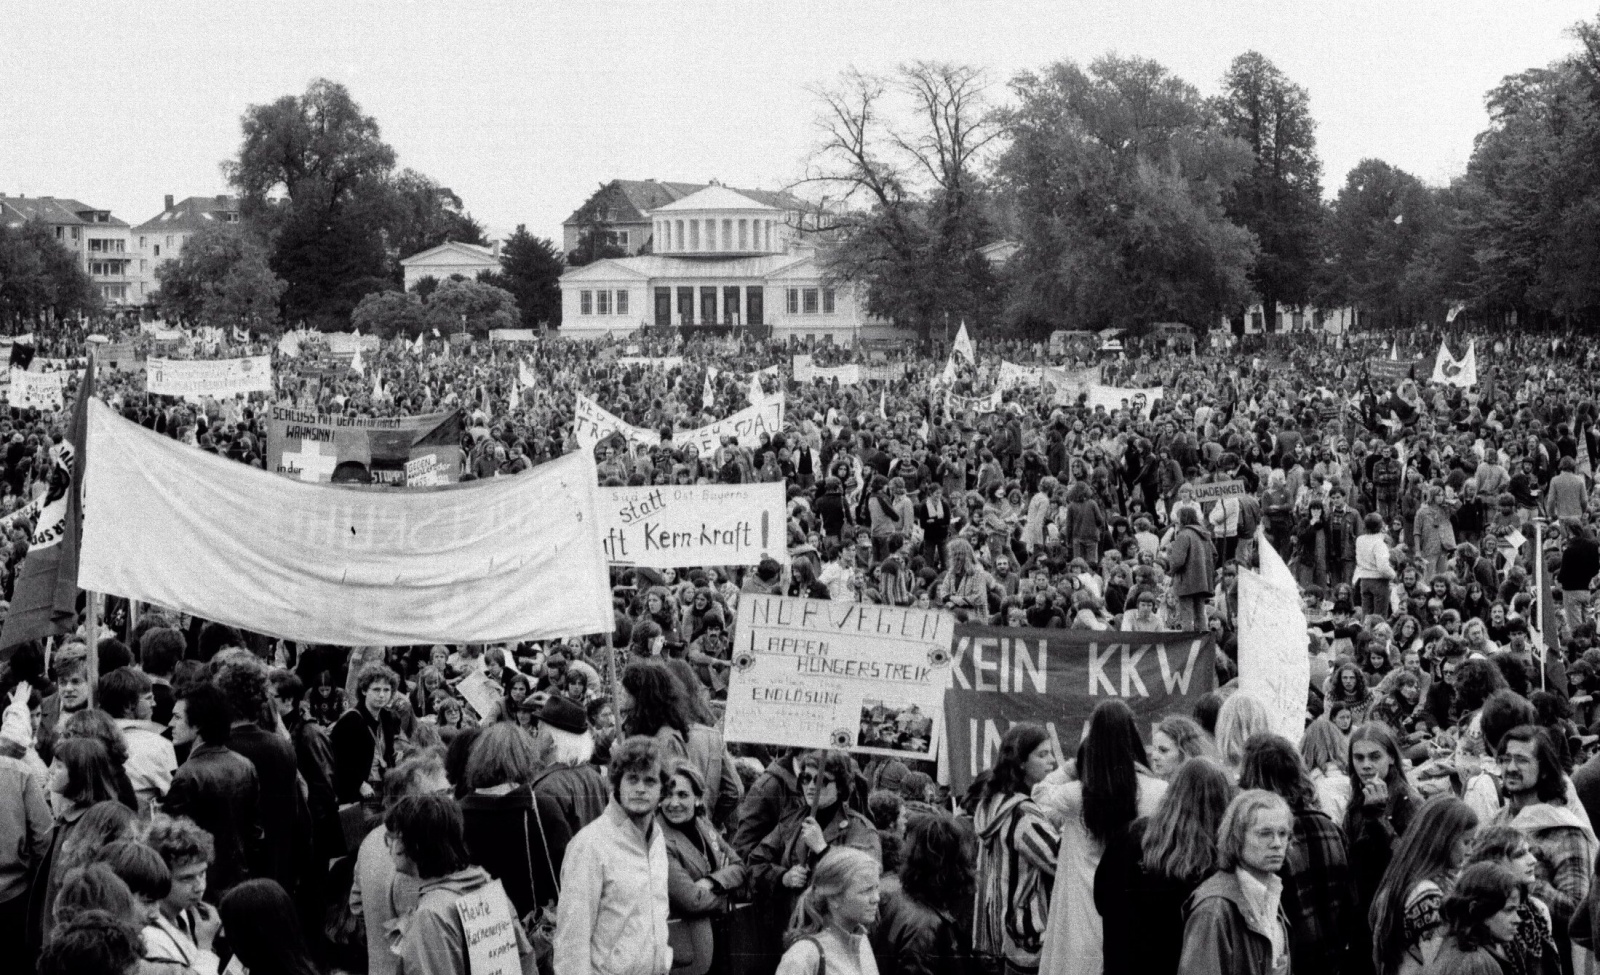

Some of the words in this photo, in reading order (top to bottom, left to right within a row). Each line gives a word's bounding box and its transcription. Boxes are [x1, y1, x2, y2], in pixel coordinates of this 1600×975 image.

[273, 407, 316, 424] SCHLUSS
[317, 413, 333, 426] MIT
[337, 416, 355, 428] DEM
[1196, 484, 1244, 498] UMDENKEN
[619, 488, 666, 523] statt
[750, 629, 831, 656] LAPPEN
[797, 656, 932, 682] HUNGERSTREIK
[945, 636, 1048, 694] KEIN
[1088, 639, 1201, 698] KKW
[459, 900, 491, 923] Heute
